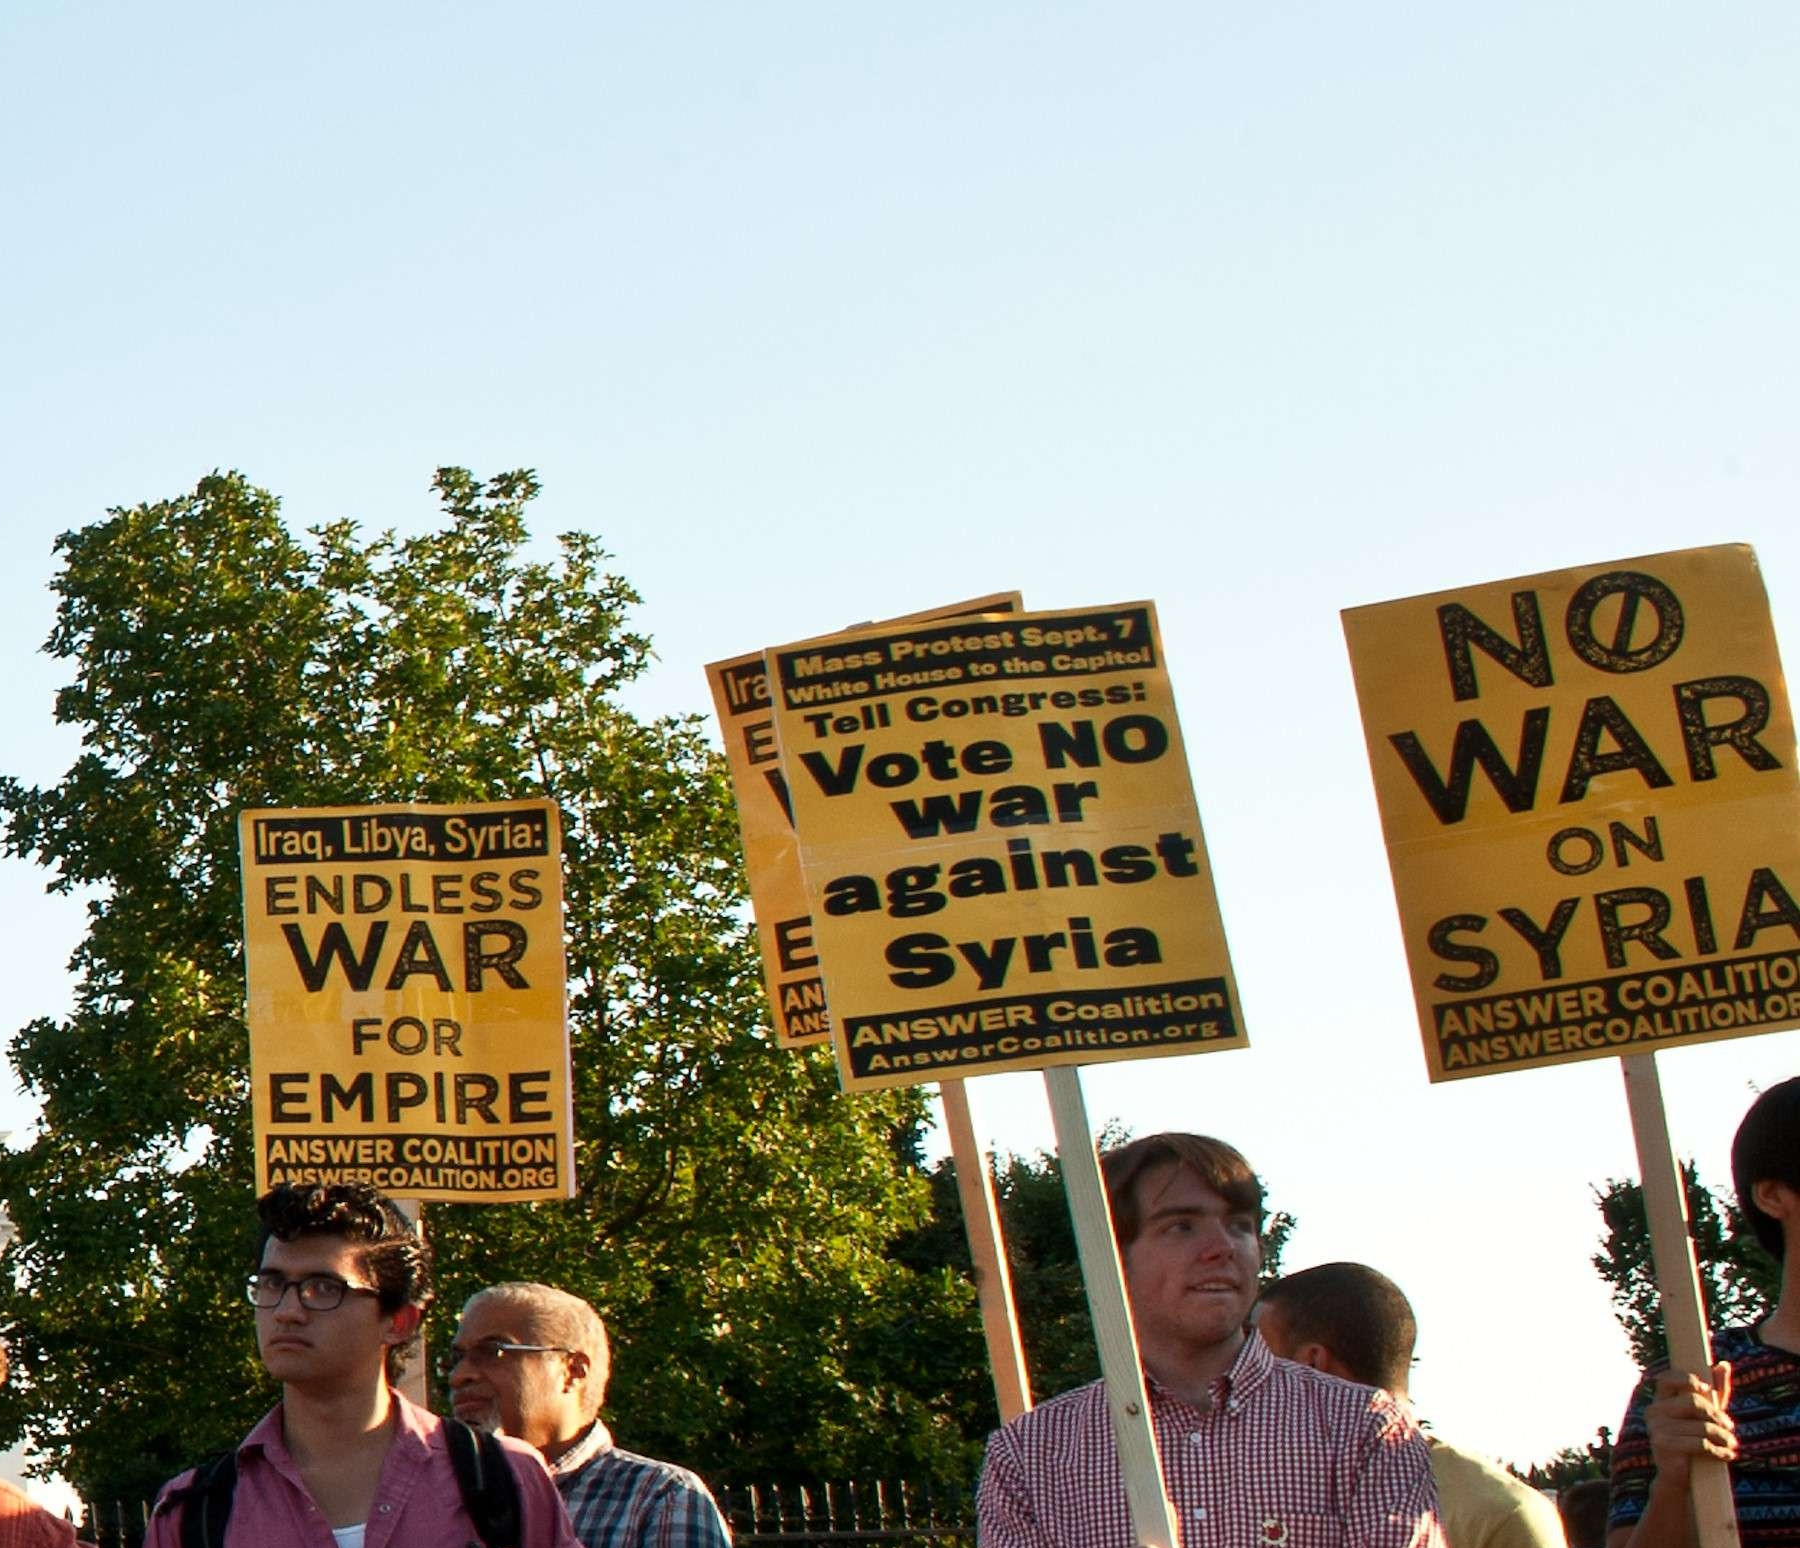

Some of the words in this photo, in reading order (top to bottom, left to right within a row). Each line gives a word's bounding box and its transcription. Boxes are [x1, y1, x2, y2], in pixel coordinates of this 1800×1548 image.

[794, 651, 882, 678] Mass
[890, 630, 1014, 663] Protest
[1020, 623, 1108, 651] Sept.
[1114, 618, 1134, 638] 7
[1437, 570, 1685, 703] NO
[725, 671, 770, 705] Ira
[787, 682, 869, 704] White
[876, 667, 961, 692] House
[967, 659, 995, 678] to
[1003, 655, 1046, 675] the
[1051, 648, 1151, 673] Capitol
[804, 703, 891, 738] Tell
[905, 682, 1146, 723] Congress:
[799, 738, 1013, 797] Vote
[1037, 714, 1168, 770] NO
[1387, 674, 1783, 826] WAR
[257, 822, 332, 860] Iraq,
[343, 818, 435, 857] Libya,
[445, 818, 542, 857] Syria:
[890, 780, 1099, 840] war
[823, 832, 1200, 918] against
[1547, 816, 1665, 877] ON
[265, 869, 543, 916] ENDLESS
[281, 919, 531, 993] WAR
[884, 916, 1162, 991] Syria
[1427, 867, 1800, 994] SYRIA
[851, 1004, 1036, 1049] ANSWER
[1046, 989, 1224, 1023] Coalition
[1441, 986, 1609, 1039] ANSWER
[1618, 955, 1800, 1010] COALITIO
[353, 1016, 463, 1057] FOR
[867, 1019, 1219, 1072] AnswerCoalition.org
[1445, 992, 1800, 1068] ANSWERCOALITION.OR
[269, 1070, 553, 1125] EMPIRE
[268, 1138, 394, 1164] ANSWER
[402, 1138, 555, 1165] COALITION
